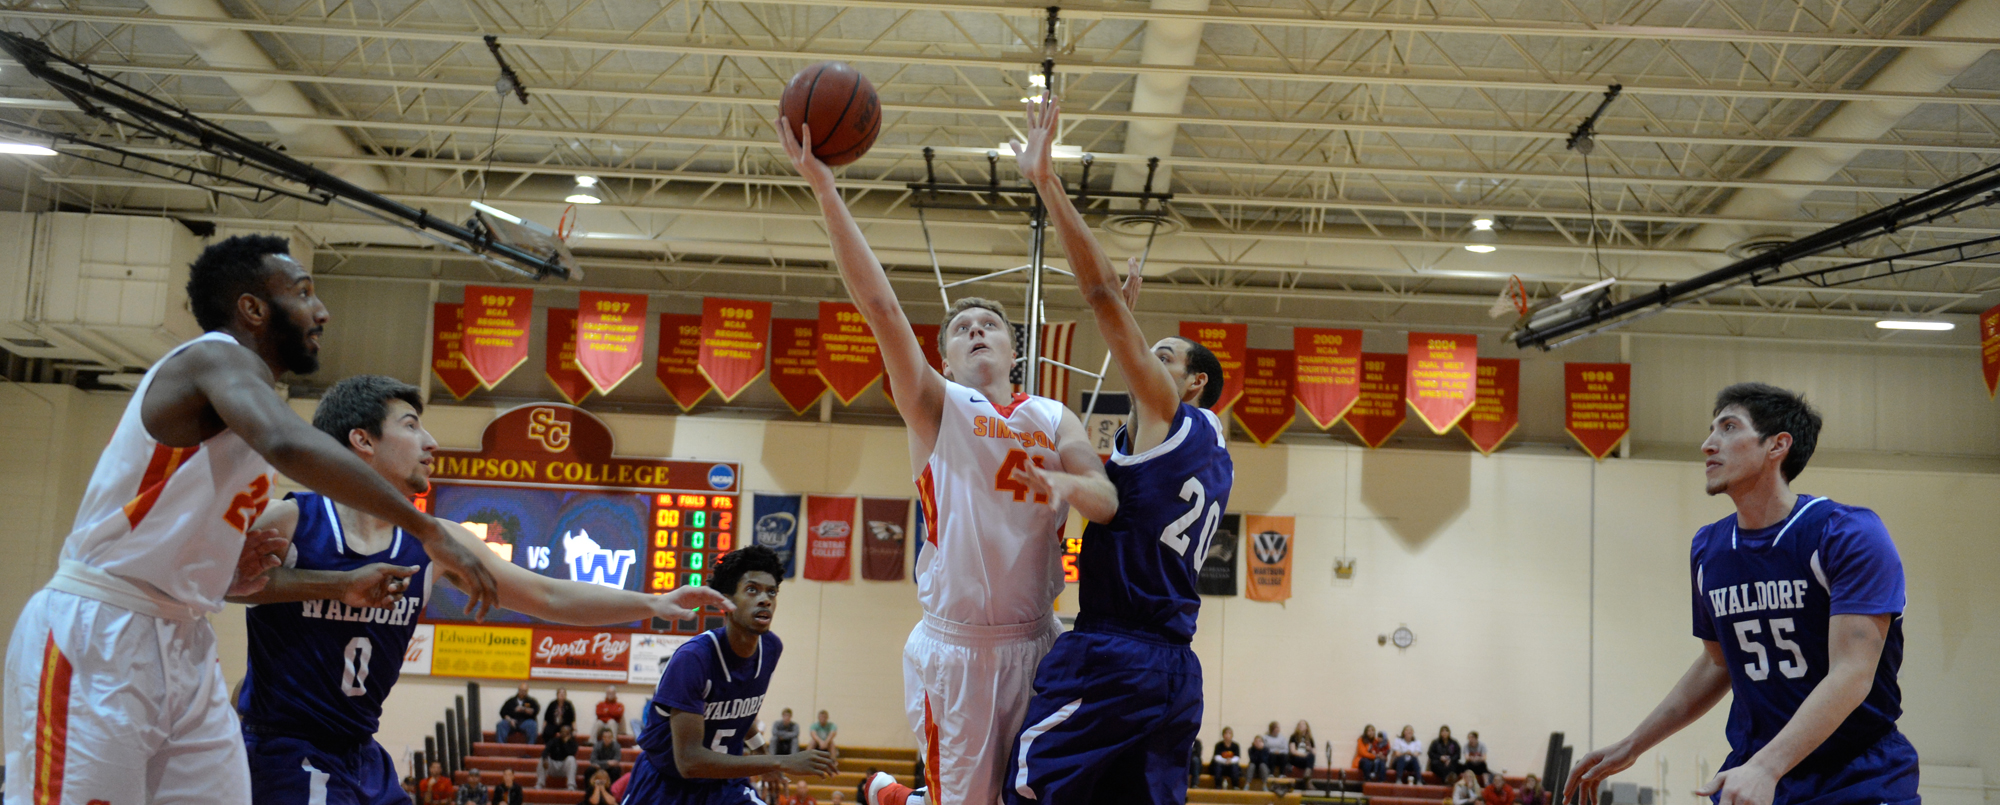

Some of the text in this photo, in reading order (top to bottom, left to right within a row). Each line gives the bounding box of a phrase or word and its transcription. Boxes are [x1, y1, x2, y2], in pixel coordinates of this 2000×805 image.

[481, 294, 516, 307] 1997
[486, 308, 508, 317] NCAA
[596, 300, 631, 314] 1997
[601, 313, 623, 323] NCAA
[720, 307, 754, 320] 1998
[477, 317, 516, 328] REGIONAL
[583, 322, 640, 333] CHAMPIONSHIP
[724, 320, 746, 329] NCAA
[466, 326, 524, 338] CHAMPIONSHIP
[714, 329, 754, 339] REGIONAL
[840, 324, 863, 333] NCAA
[1198, 328, 1227, 340] 1999
[475, 337, 514, 347] FOOTBALL
[704, 338, 763, 350] CHAMPIONSHIP
[822, 333, 878, 344] CHAMPIONSHI
[1313, 334, 1342, 346] 2000
[589, 342, 629, 353] FOOTBALL
[825, 343, 877, 354] THIRD PLACE
[1316, 346, 1339, 354] NCAA
[1427, 339, 1457, 350] 2004
[713, 348, 752, 359] SOFTBALL
[830, 353, 869, 364] SOFTBALL
[1298, 355, 1358, 365] CHAMPIONSHIP
[1418, 360, 1465, 370] DUAL MEET
[1298, 365, 1356, 375] FOURTH PLACE
[1412, 370, 1471, 380] CHAMPIONSHIP
[1335, 376, 1356, 385] GOLF
[1581, 371, 1614, 382] 1998
[1415, 379, 1468, 390] THIRD PLACE
[1419, 390, 1464, 400] WRESTLING
[528, 408, 571, 453] SC
[545, 460, 669, 485] COLLEGE
[679, 496, 706, 507] FOULS
[712, 498, 733, 509] PTS.
[657, 509, 732, 530] 00 0 2
[1160, 476, 1220, 575] 20
[655, 530, 731, 550] 01 0 0
[812, 540, 846, 549] CENTRAL
[811, 548, 846, 558] COLLEGE
[1251, 533, 1291, 562] W
[527, 546, 550, 569] VS
[653, 550, 703, 570] 05 0
[652, 572, 676, 590] 20
[1708, 580, 1808, 618] WALDORF
[301, 597, 420, 626] WALDORF
[439, 629, 527, 646] Edward Jones
[535, 632, 630, 664] Sports Page
[1733, 617, 1808, 682] 55
[341, 636, 373, 697] 0
[704, 693, 766, 720] WALDORF
